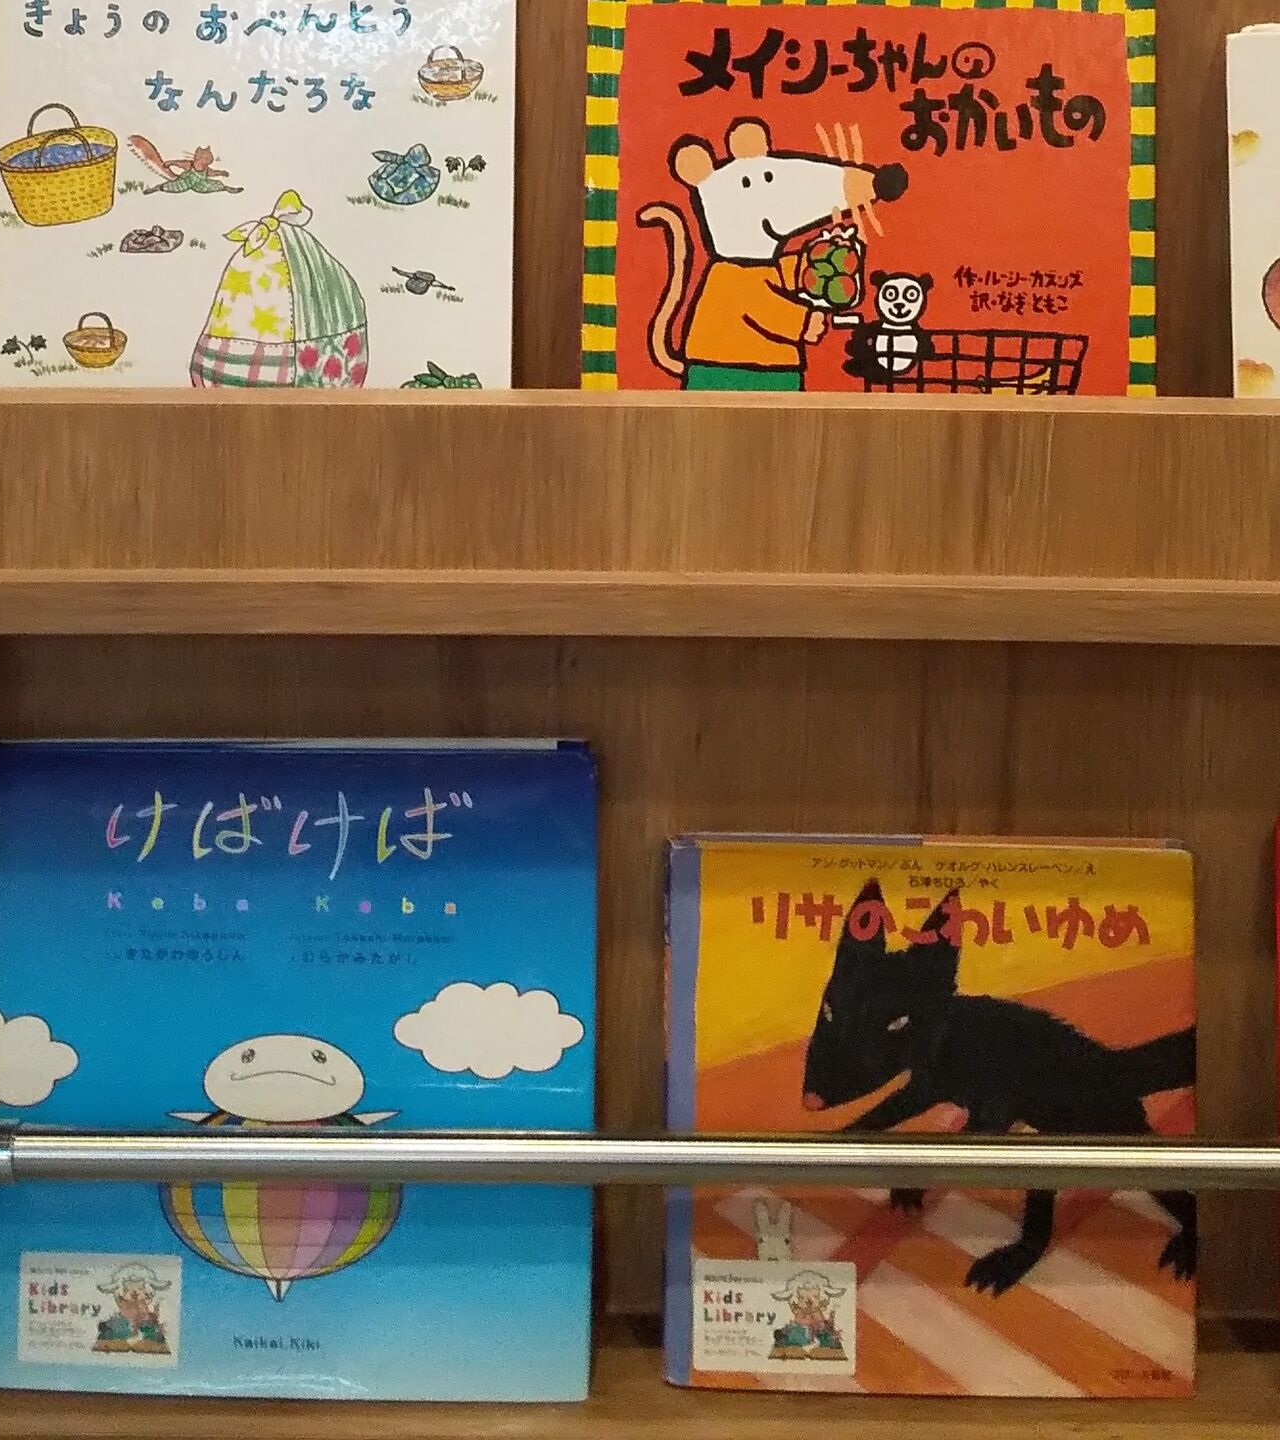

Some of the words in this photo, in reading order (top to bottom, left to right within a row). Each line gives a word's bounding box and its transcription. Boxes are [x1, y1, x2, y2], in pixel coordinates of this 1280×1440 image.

[678, 25, 996, 100] メイシーちゃんの
[144, 68, 377, 113] なんだろな
[899, 63, 1108, 158] おかいもの
[106, 787, 474, 881] けばけば
[751, 891, 1151, 951] リサのこわいゆめ
[28, 1280, 71, 1297] Kids
[28, 1298, 102, 1317] Library
[703, 1290, 745, 1305] Kids
[703, 1307, 777, 1326] Library
